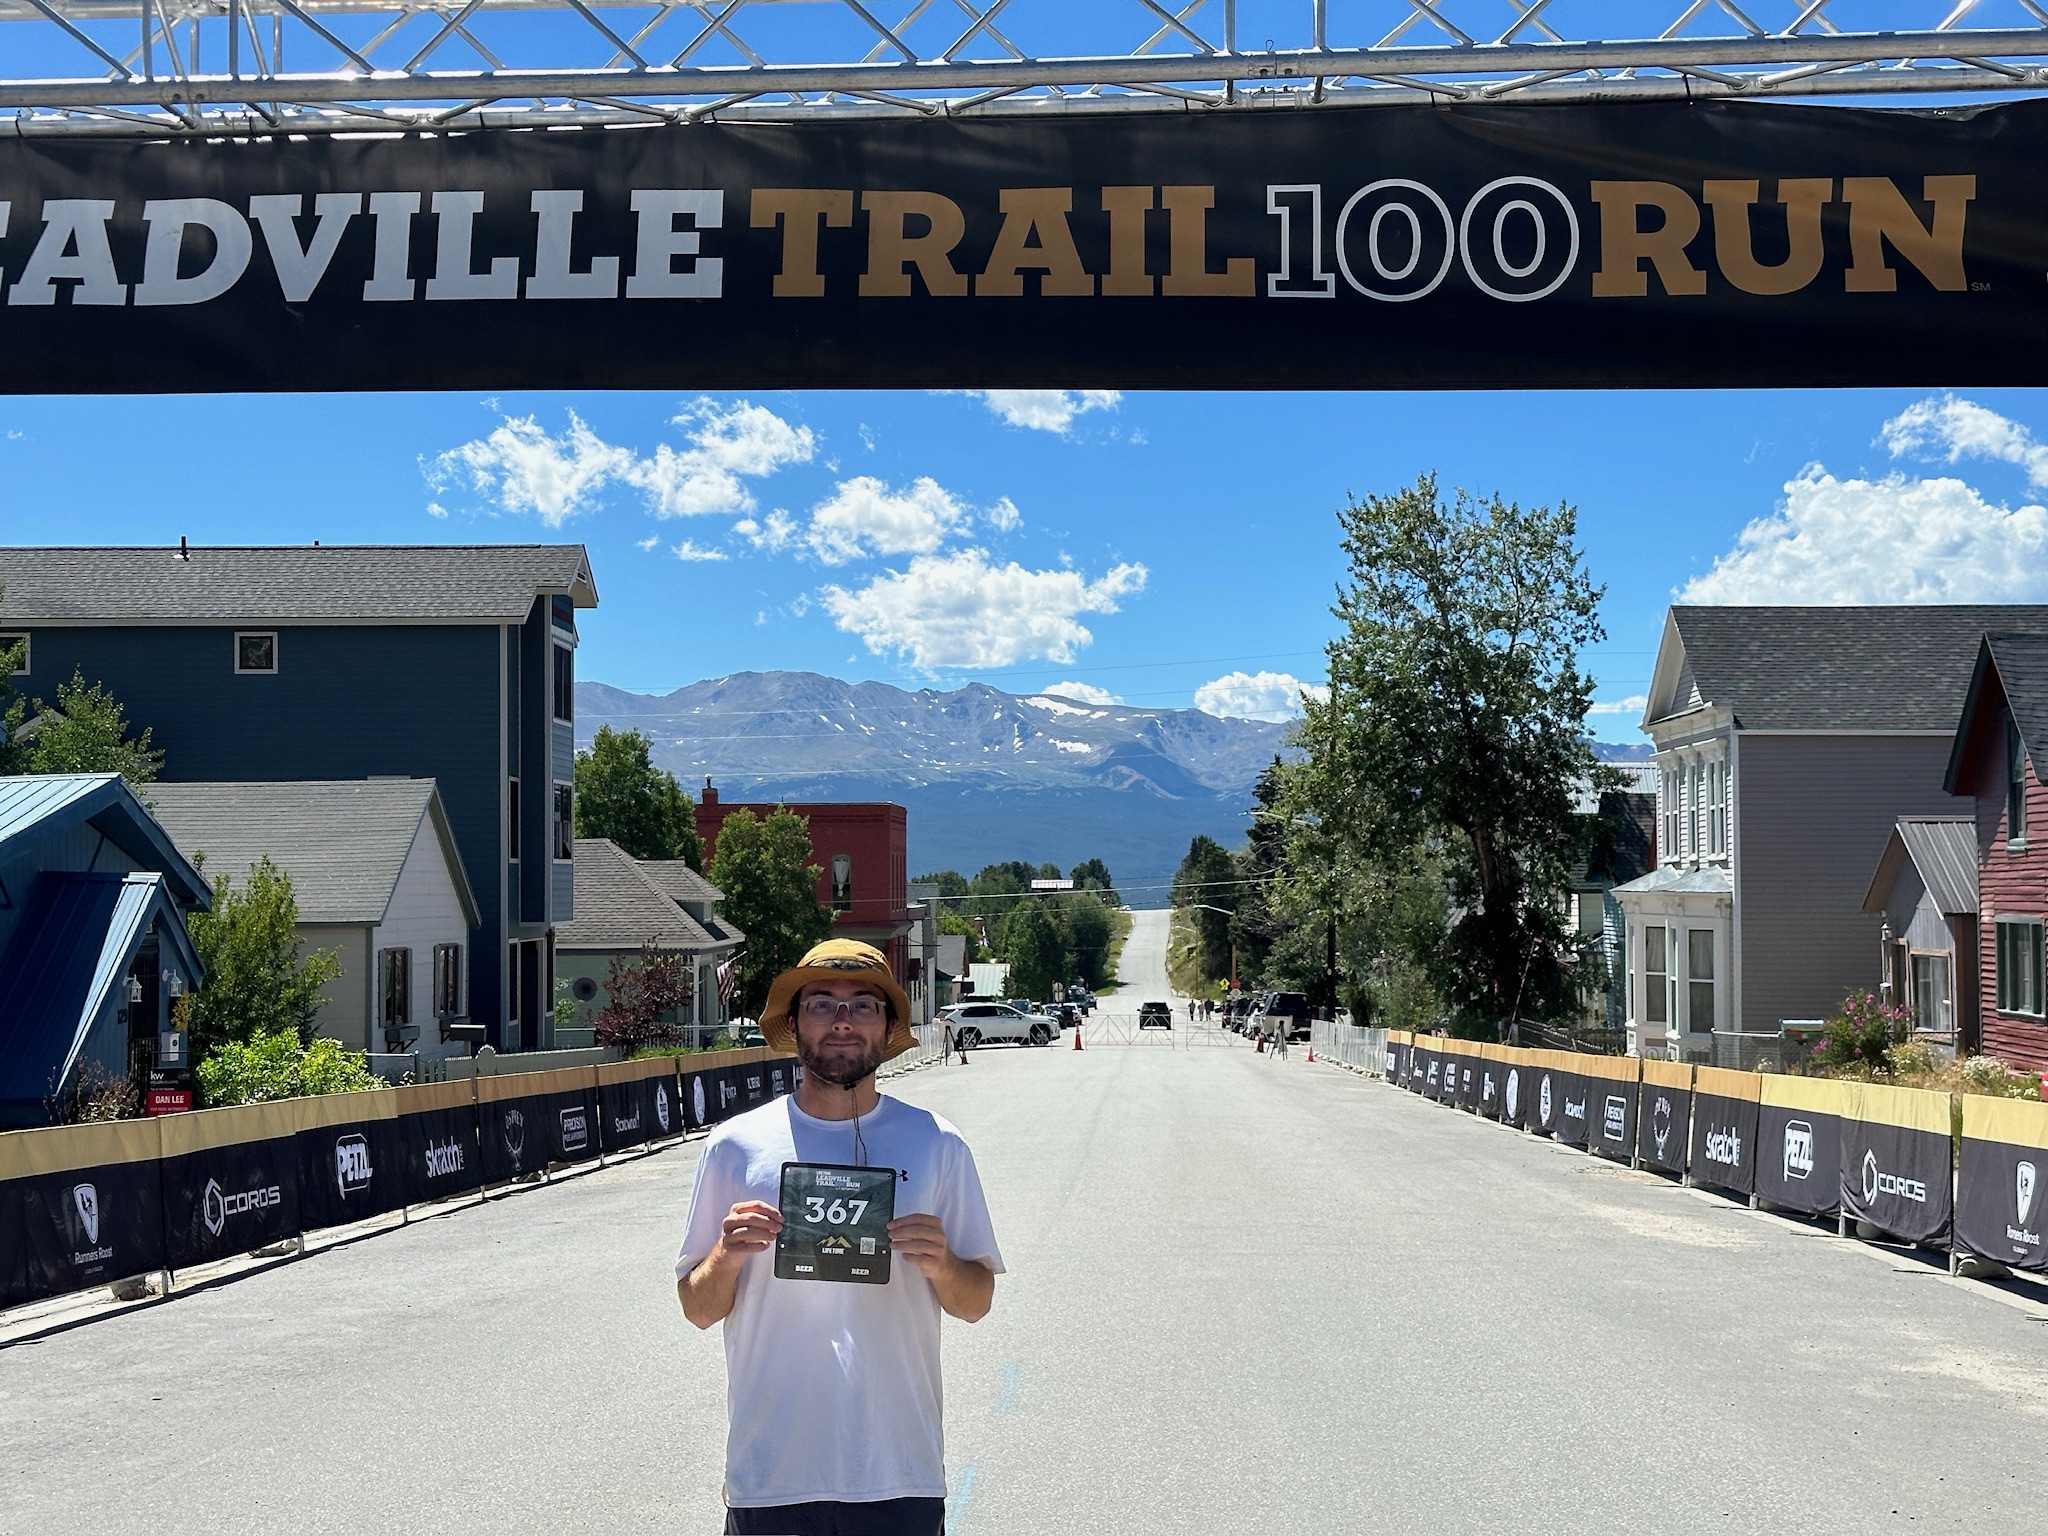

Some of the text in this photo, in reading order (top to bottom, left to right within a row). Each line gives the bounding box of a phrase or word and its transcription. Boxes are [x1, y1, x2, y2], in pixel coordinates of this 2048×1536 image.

[0, 174, 1976, 306] ADVILLE TRAIL 100 RUN
[1971, 282, 1991, 291] SM
[155, 1095, 185, 1104] DAN LEE
[335, 1143, 373, 1200] PETZL
[224, 1185, 281, 1216] COROS
[1878, 1172, 1926, 1202] COROS
[804, 1197, 869, 1225] 367
